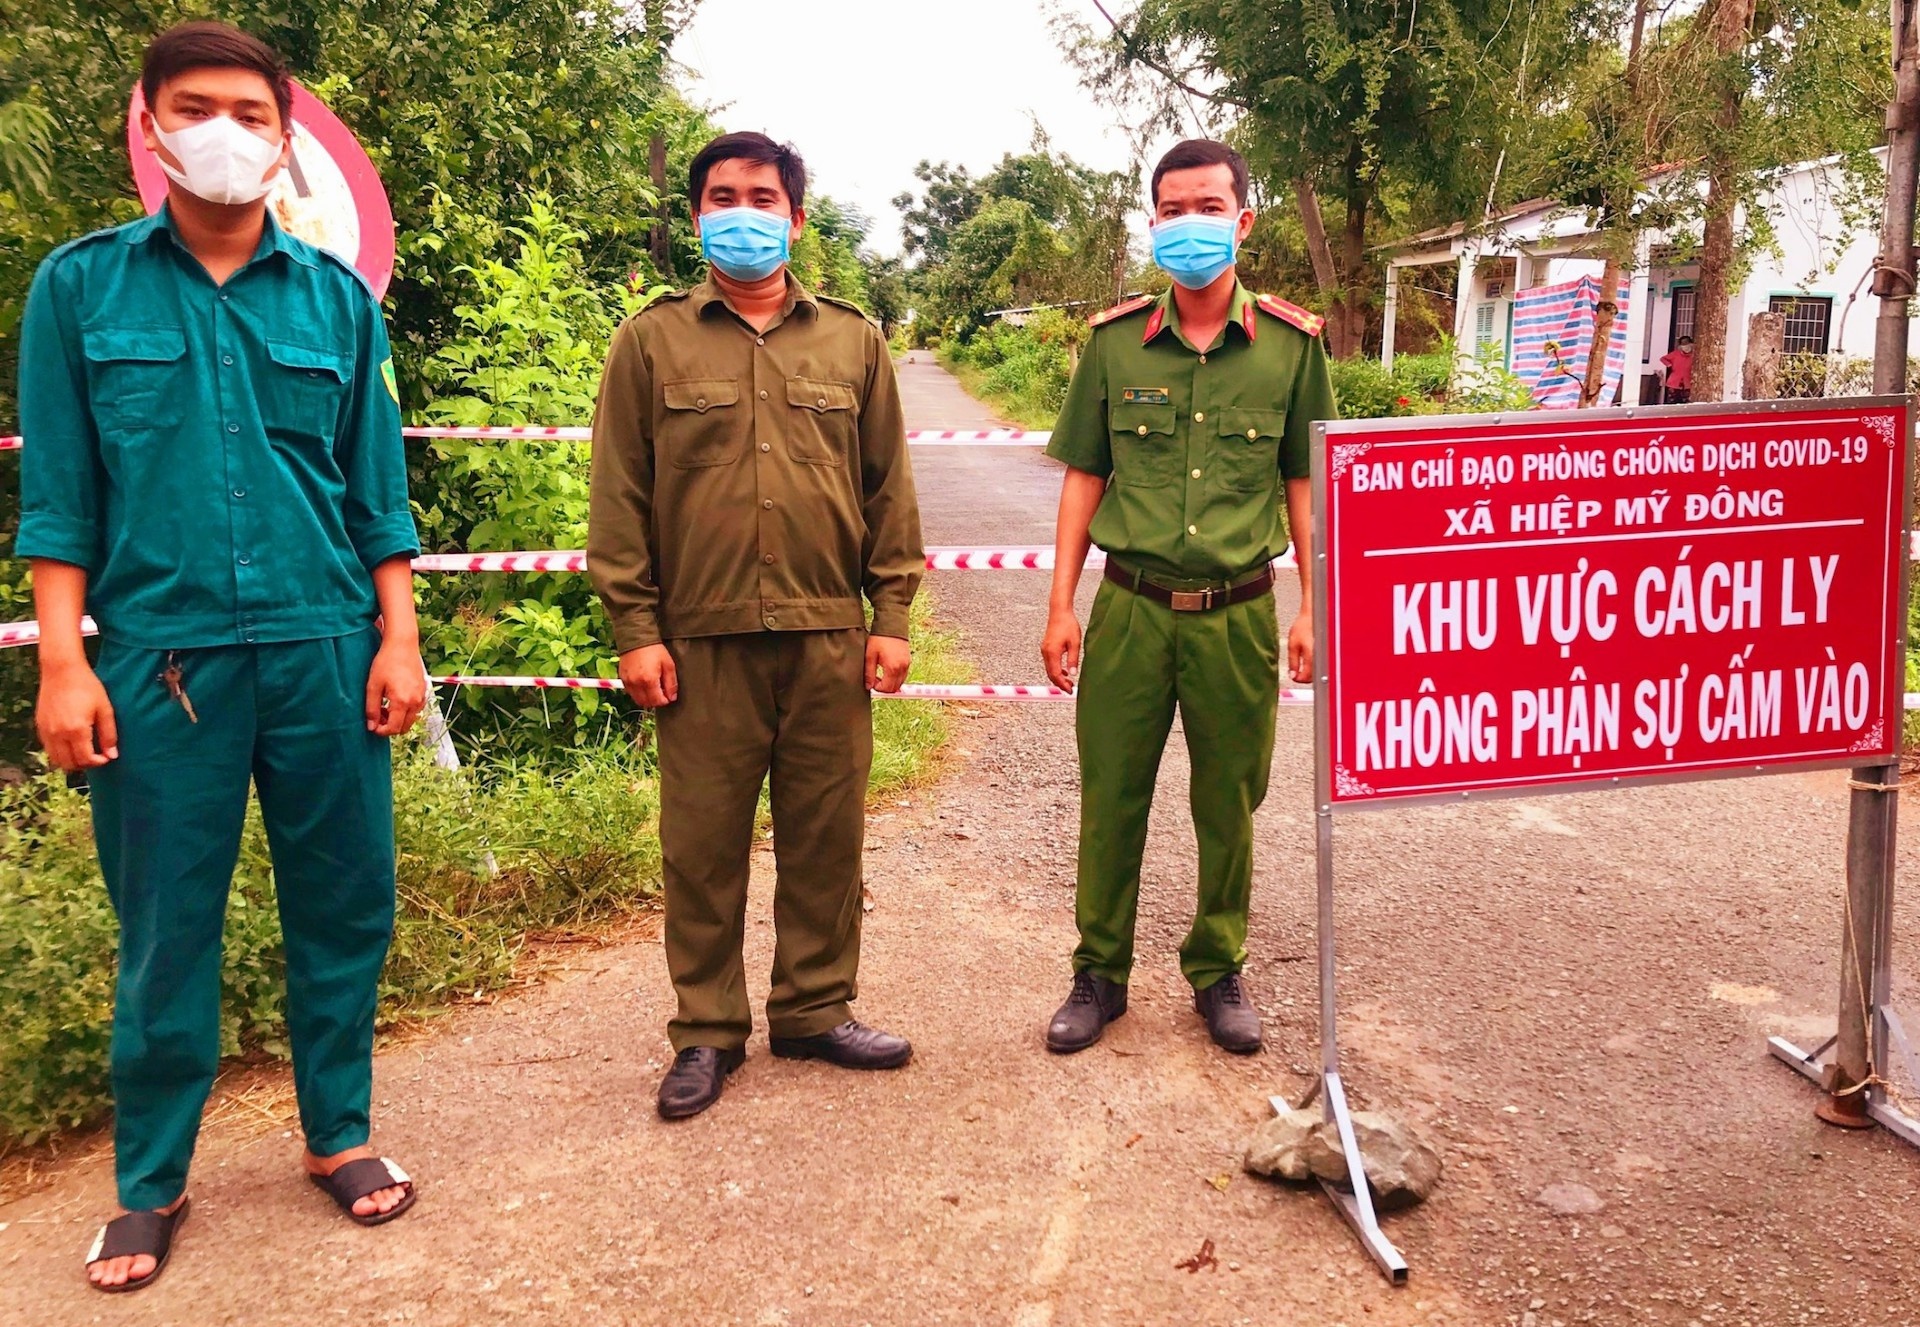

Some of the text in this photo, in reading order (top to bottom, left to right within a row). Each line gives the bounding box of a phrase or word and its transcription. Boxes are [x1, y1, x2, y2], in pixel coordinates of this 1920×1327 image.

[1353, 435, 1868, 492] BAN CHỈ ĐẠO PHÒNG CHỐNG DỊCH COVID-19
[1444, 484, 1784, 537] XÃ HIỆP MỸ ĐÔNG
[1393, 545, 1840, 658] KHU VỰC CÁCH LY
[1355, 643, 1869, 772] KHÔNG PHẬN SỰ CẤM VÀO
